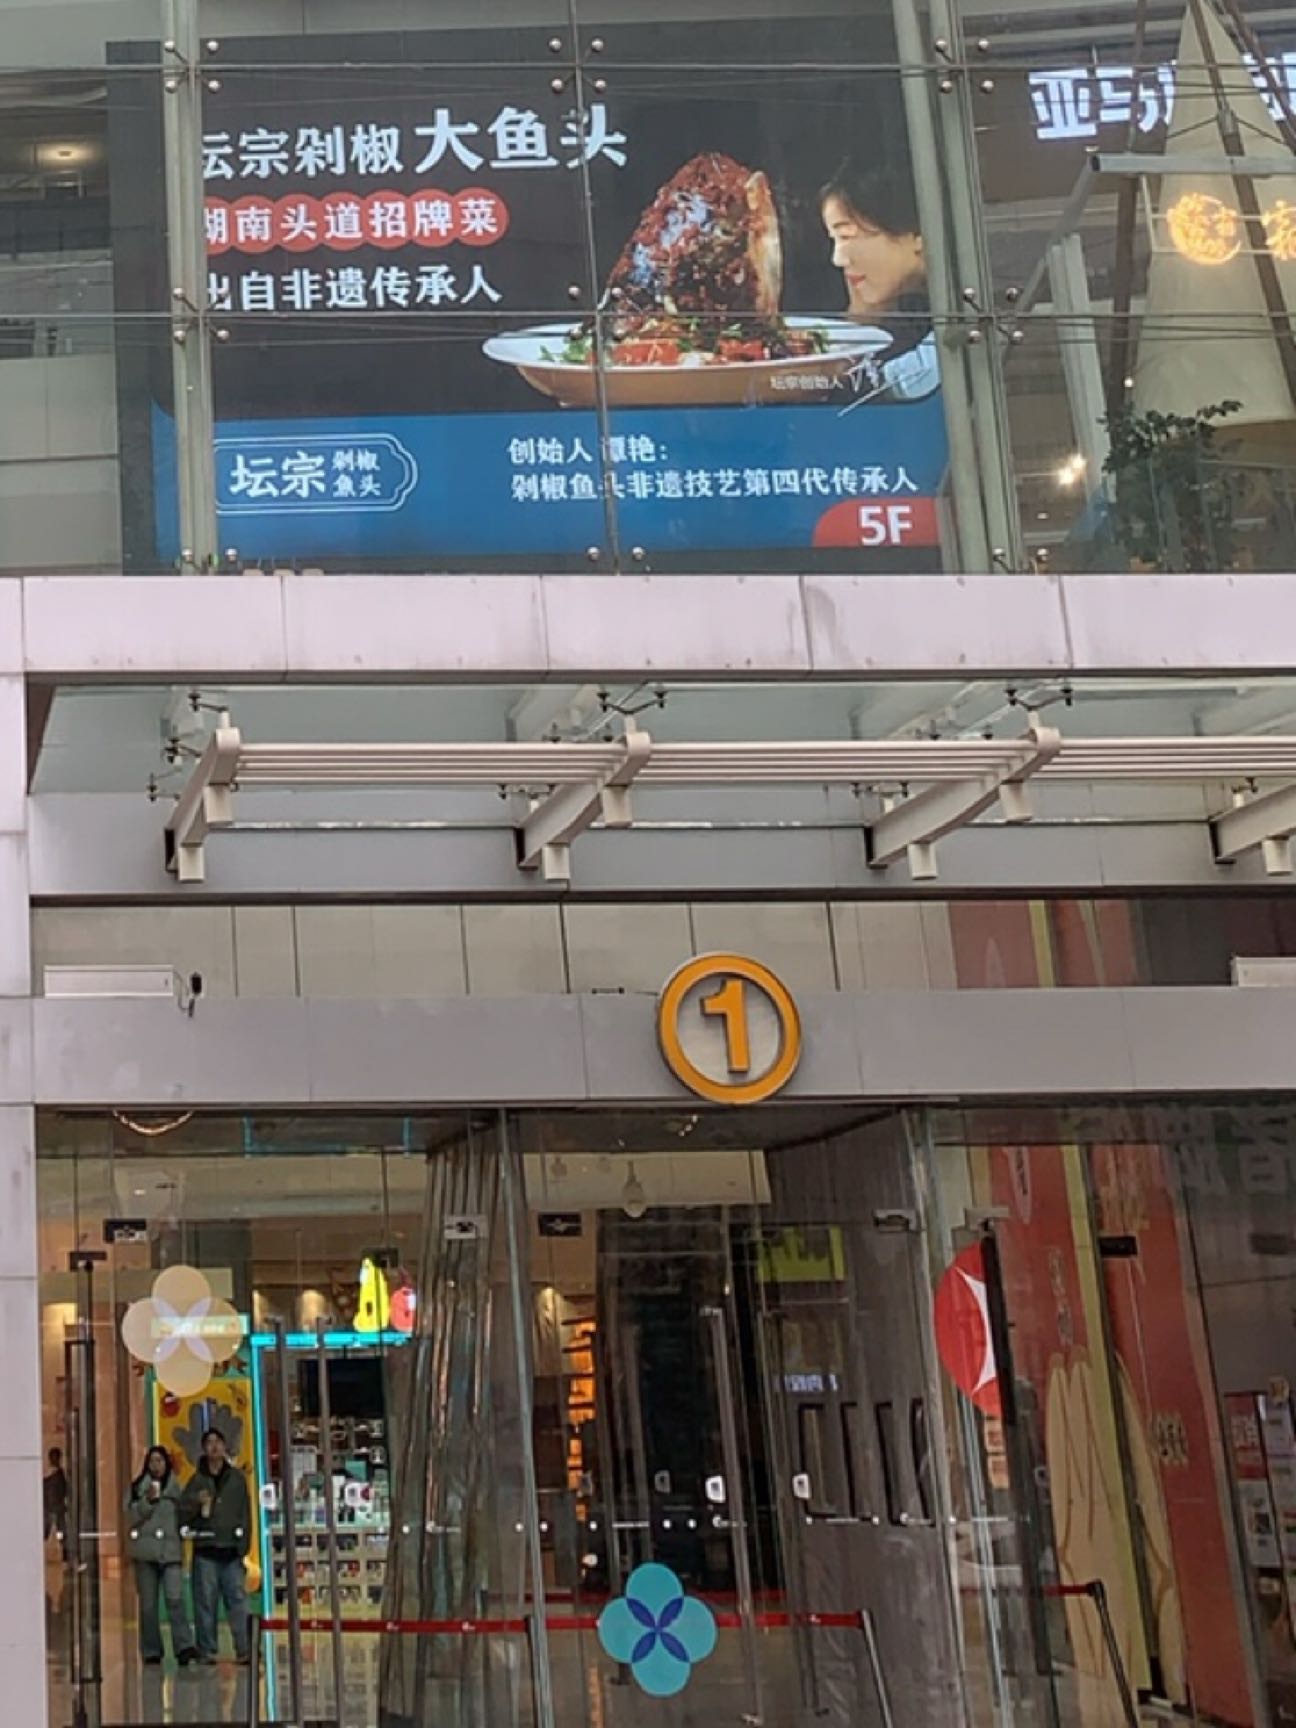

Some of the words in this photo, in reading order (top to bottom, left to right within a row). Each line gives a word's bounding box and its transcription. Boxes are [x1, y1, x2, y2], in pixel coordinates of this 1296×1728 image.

[507, 436, 593, 465] 创始人
[229, 450, 327, 498] 坛宗
[858, 504, 913, 547] 5F
[700, 978, 751, 1074] 1
